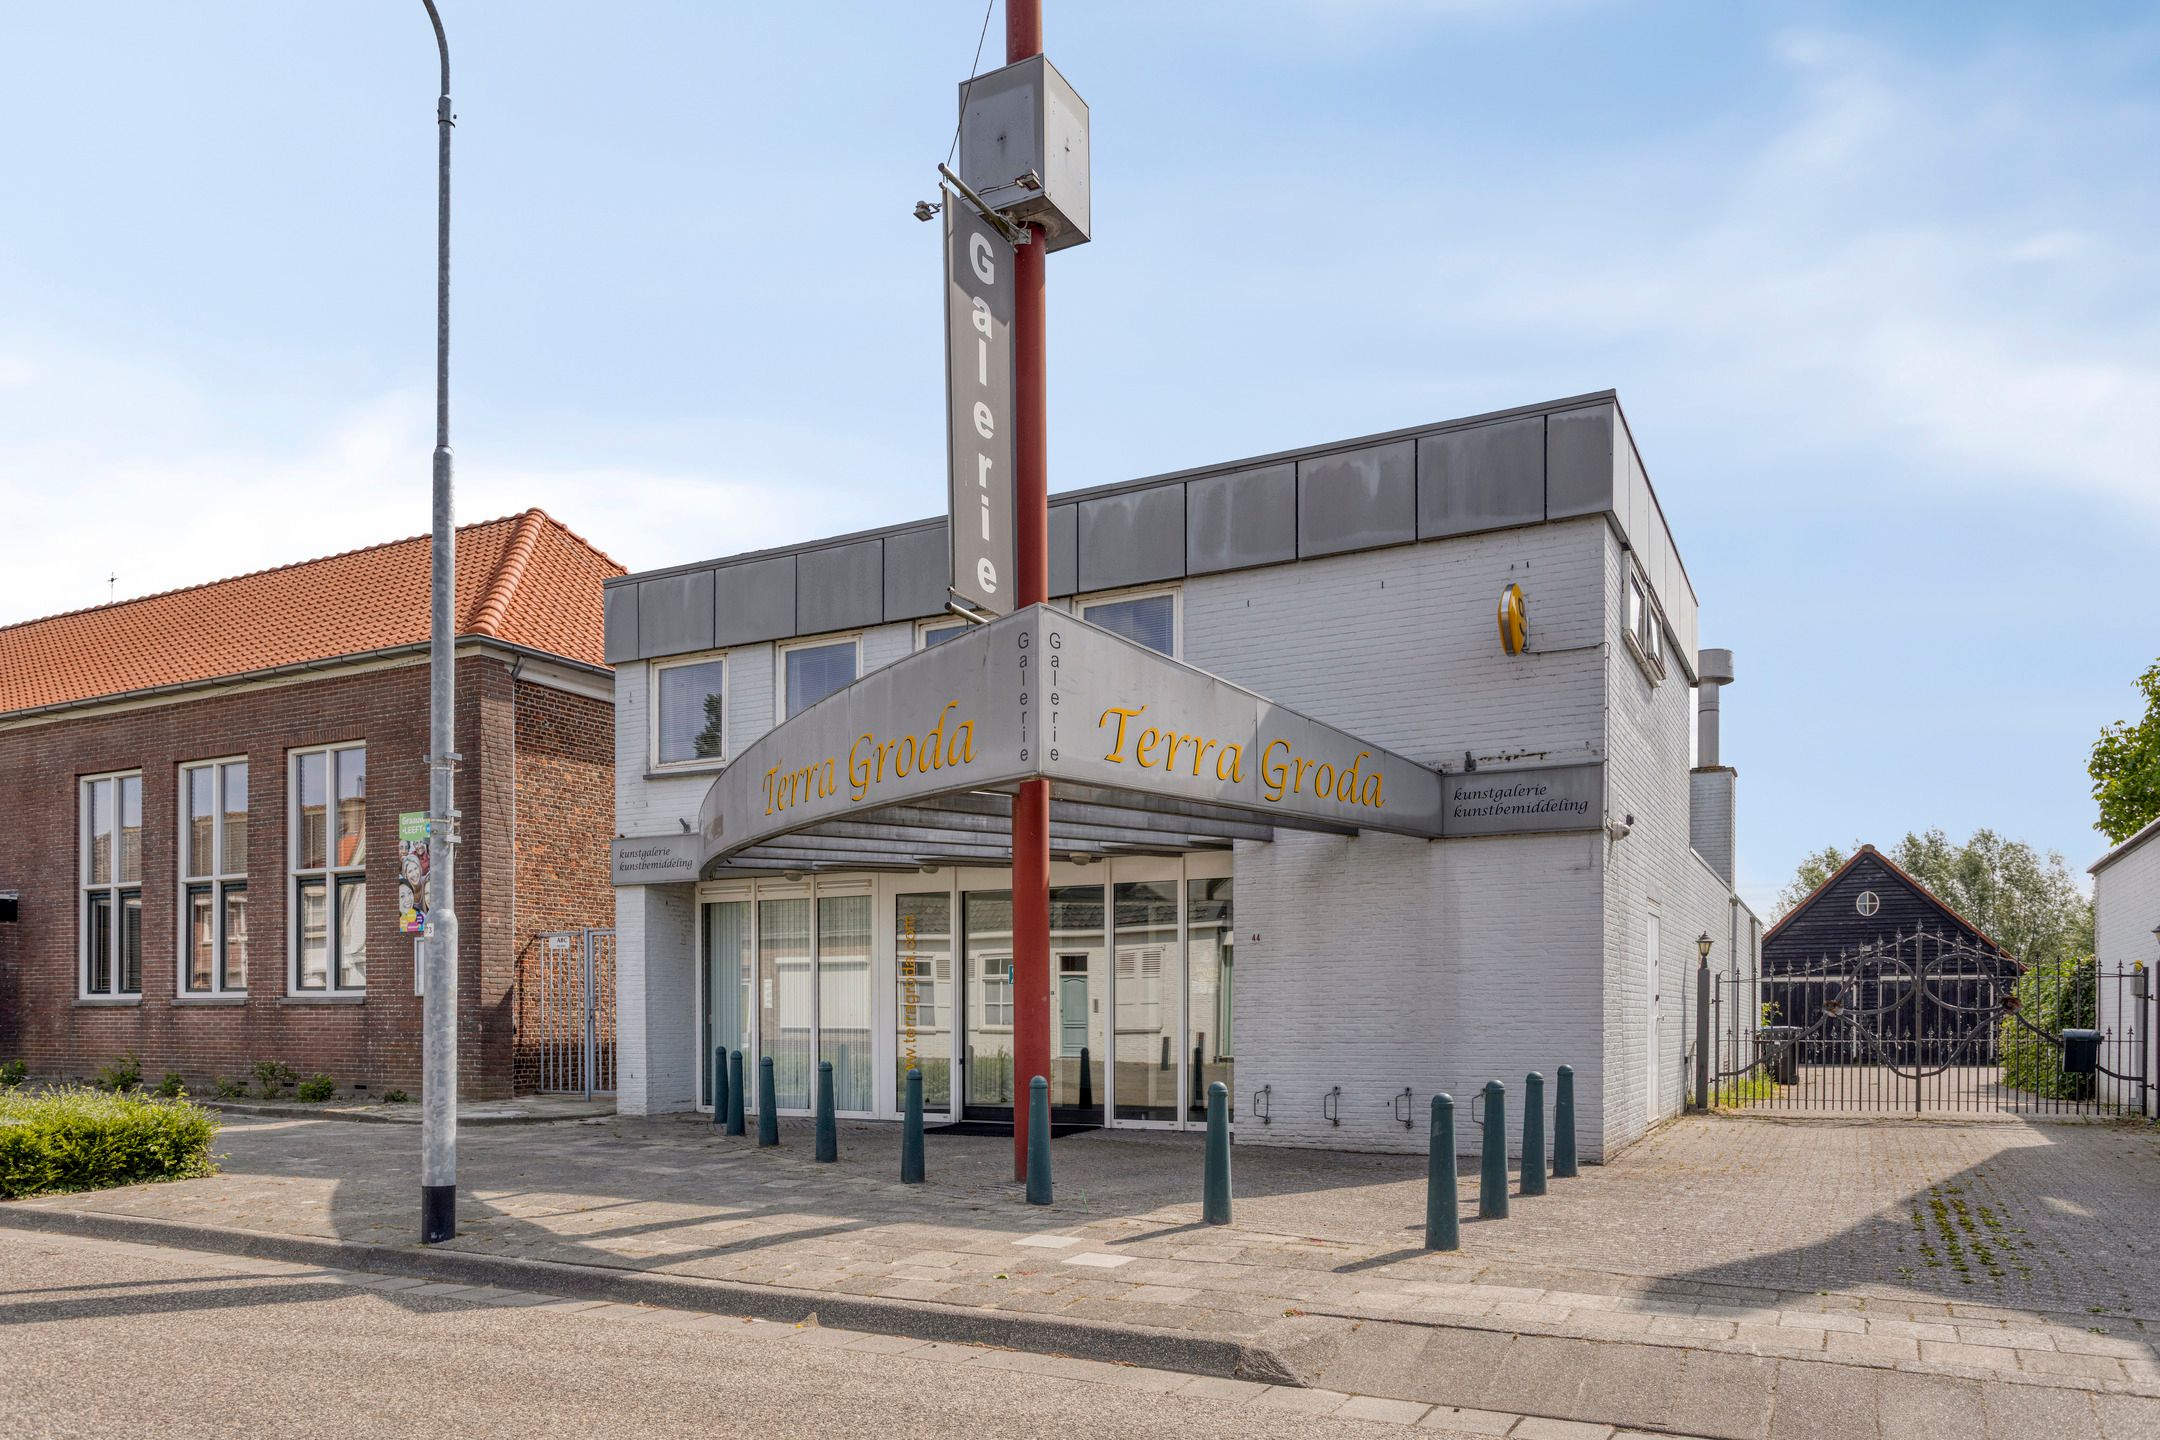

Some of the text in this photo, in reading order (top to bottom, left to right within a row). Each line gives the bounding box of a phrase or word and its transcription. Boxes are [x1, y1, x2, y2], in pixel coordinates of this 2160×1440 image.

[969, 231, 997, 594] Galerie
[1018, 632, 1029, 761] Galerie
[1049, 632, 1061, 761] Galerie
[763, 700, 977, 816] Terra Groda
[1099, 704, 1386, 808] Terra Groda
[1453, 783, 1547, 803] kunstgalerie
[1453, 798, 1588, 818] kunstbemiddeling
[619, 846, 671, 860] kunstgalerie
[619, 858, 693, 871] kunstbemiddeling
[1251, 933, 1261, 941] 44
[902, 915, 920, 1070] ww.terragroda.com
